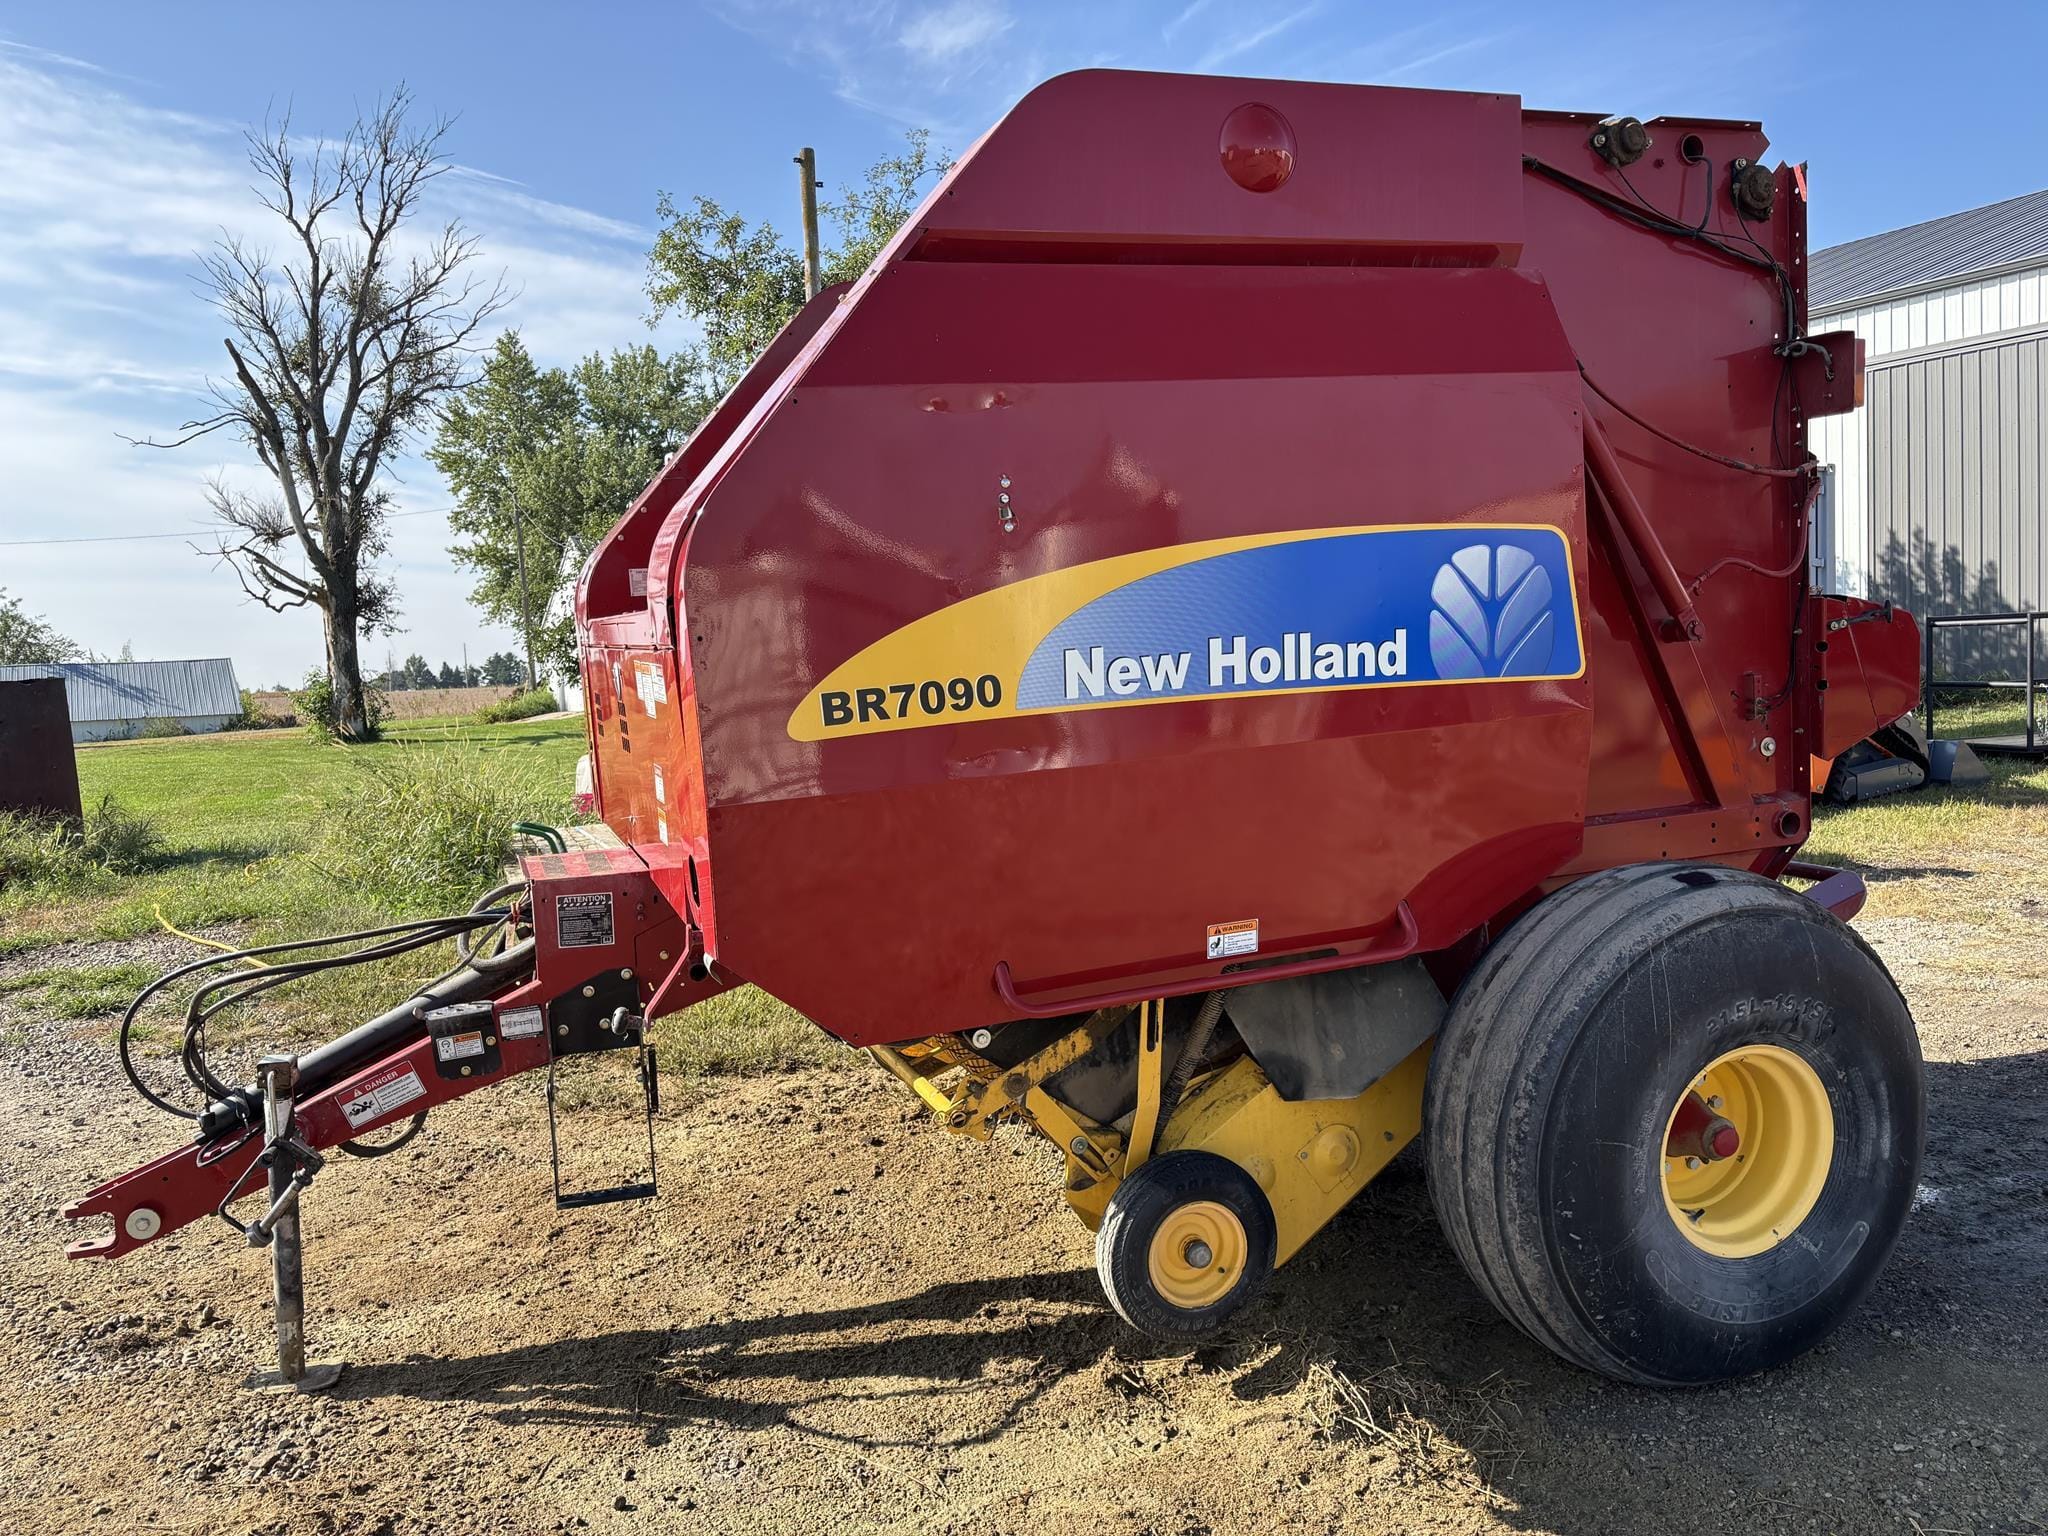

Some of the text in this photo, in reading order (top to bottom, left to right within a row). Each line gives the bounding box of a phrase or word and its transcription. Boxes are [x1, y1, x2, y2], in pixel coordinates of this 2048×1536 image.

[1063, 628, 1408, 700] New Holland
[820, 674, 1002, 727] BR7090
[563, 894, 606, 904] ATTENTION
[1221, 922, 1254, 932] WARNING
[364, 1071, 399, 1091] DANGER
